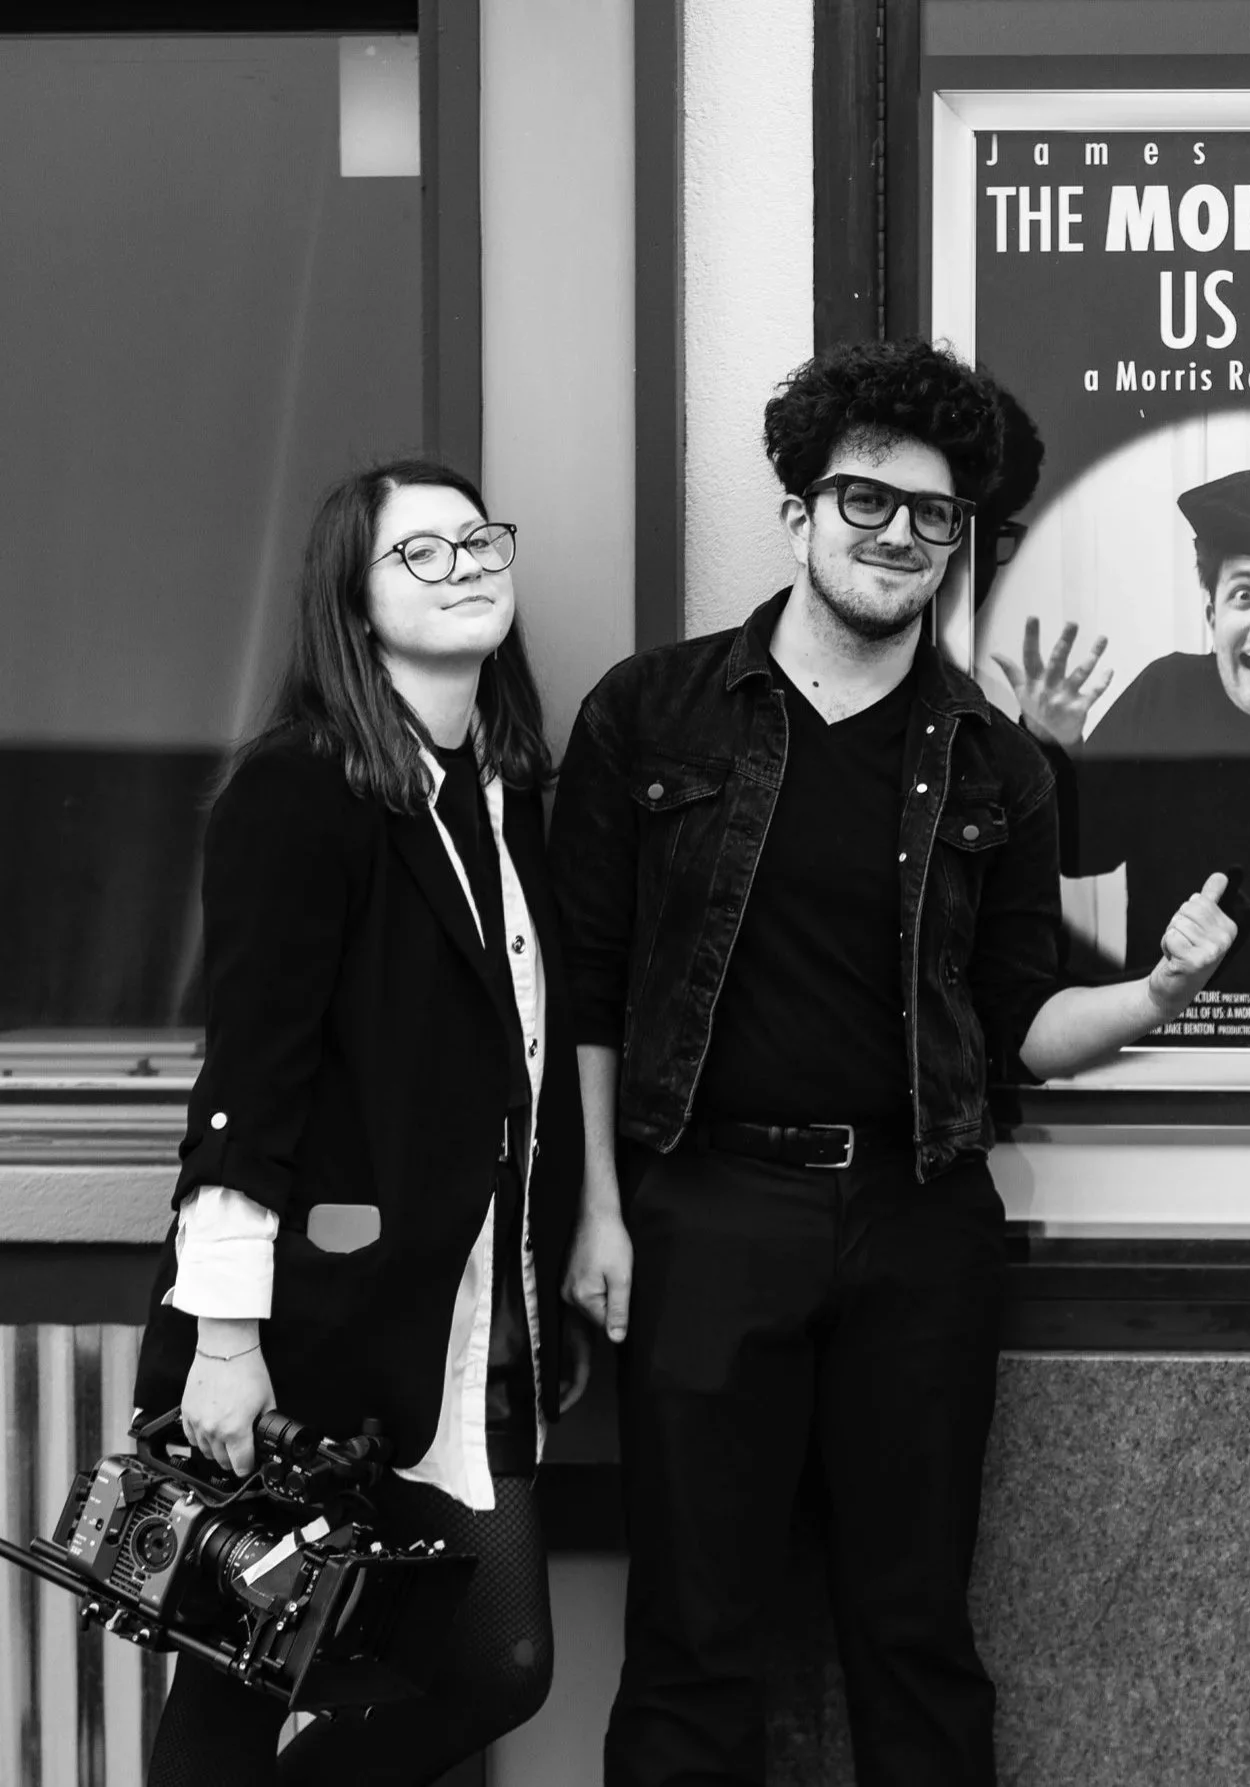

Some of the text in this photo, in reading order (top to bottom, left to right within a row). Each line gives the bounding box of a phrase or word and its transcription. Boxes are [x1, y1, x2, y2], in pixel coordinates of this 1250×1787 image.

[986, 134, 1206, 166] James
[986, 185, 1084, 253] THE
[1159, 269, 1237, 350] US
[1084, 369, 1099, 392] a
[1115, 360, 1213, 392] Morris
[1185, 1006, 1199, 1019] ALL
[1200, 1006, 1211, 1019] OF
[1226, 1007, 1234, 1019] A
[1221, 993, 1250, 1003] PRESENTS
[1163, 1023, 1182, 1035] JAKE
[1183, 1023, 1215, 1035] BENTON
